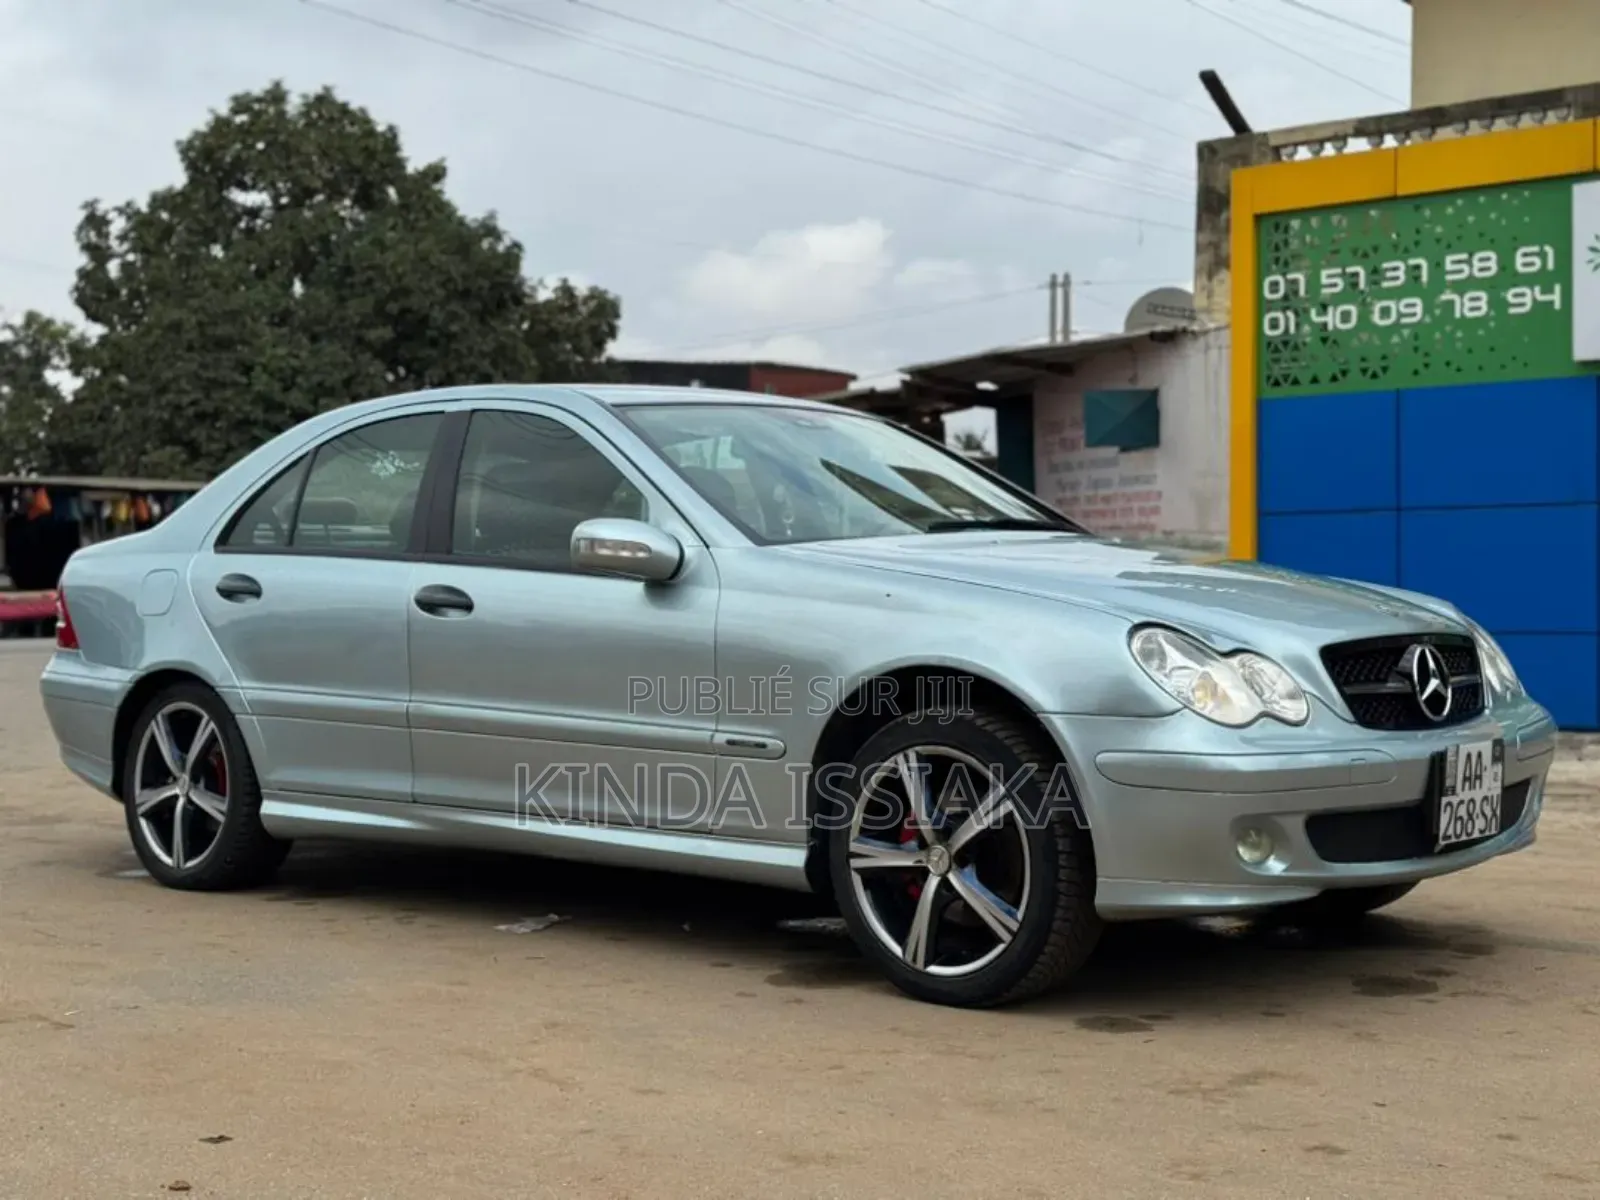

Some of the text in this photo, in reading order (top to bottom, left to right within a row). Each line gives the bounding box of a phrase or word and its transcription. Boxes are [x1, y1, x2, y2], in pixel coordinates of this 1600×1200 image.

[1263, 246, 1555, 300] 07 57 37 58 61
[1263, 283, 1561, 337] 01 40 09 78 94
